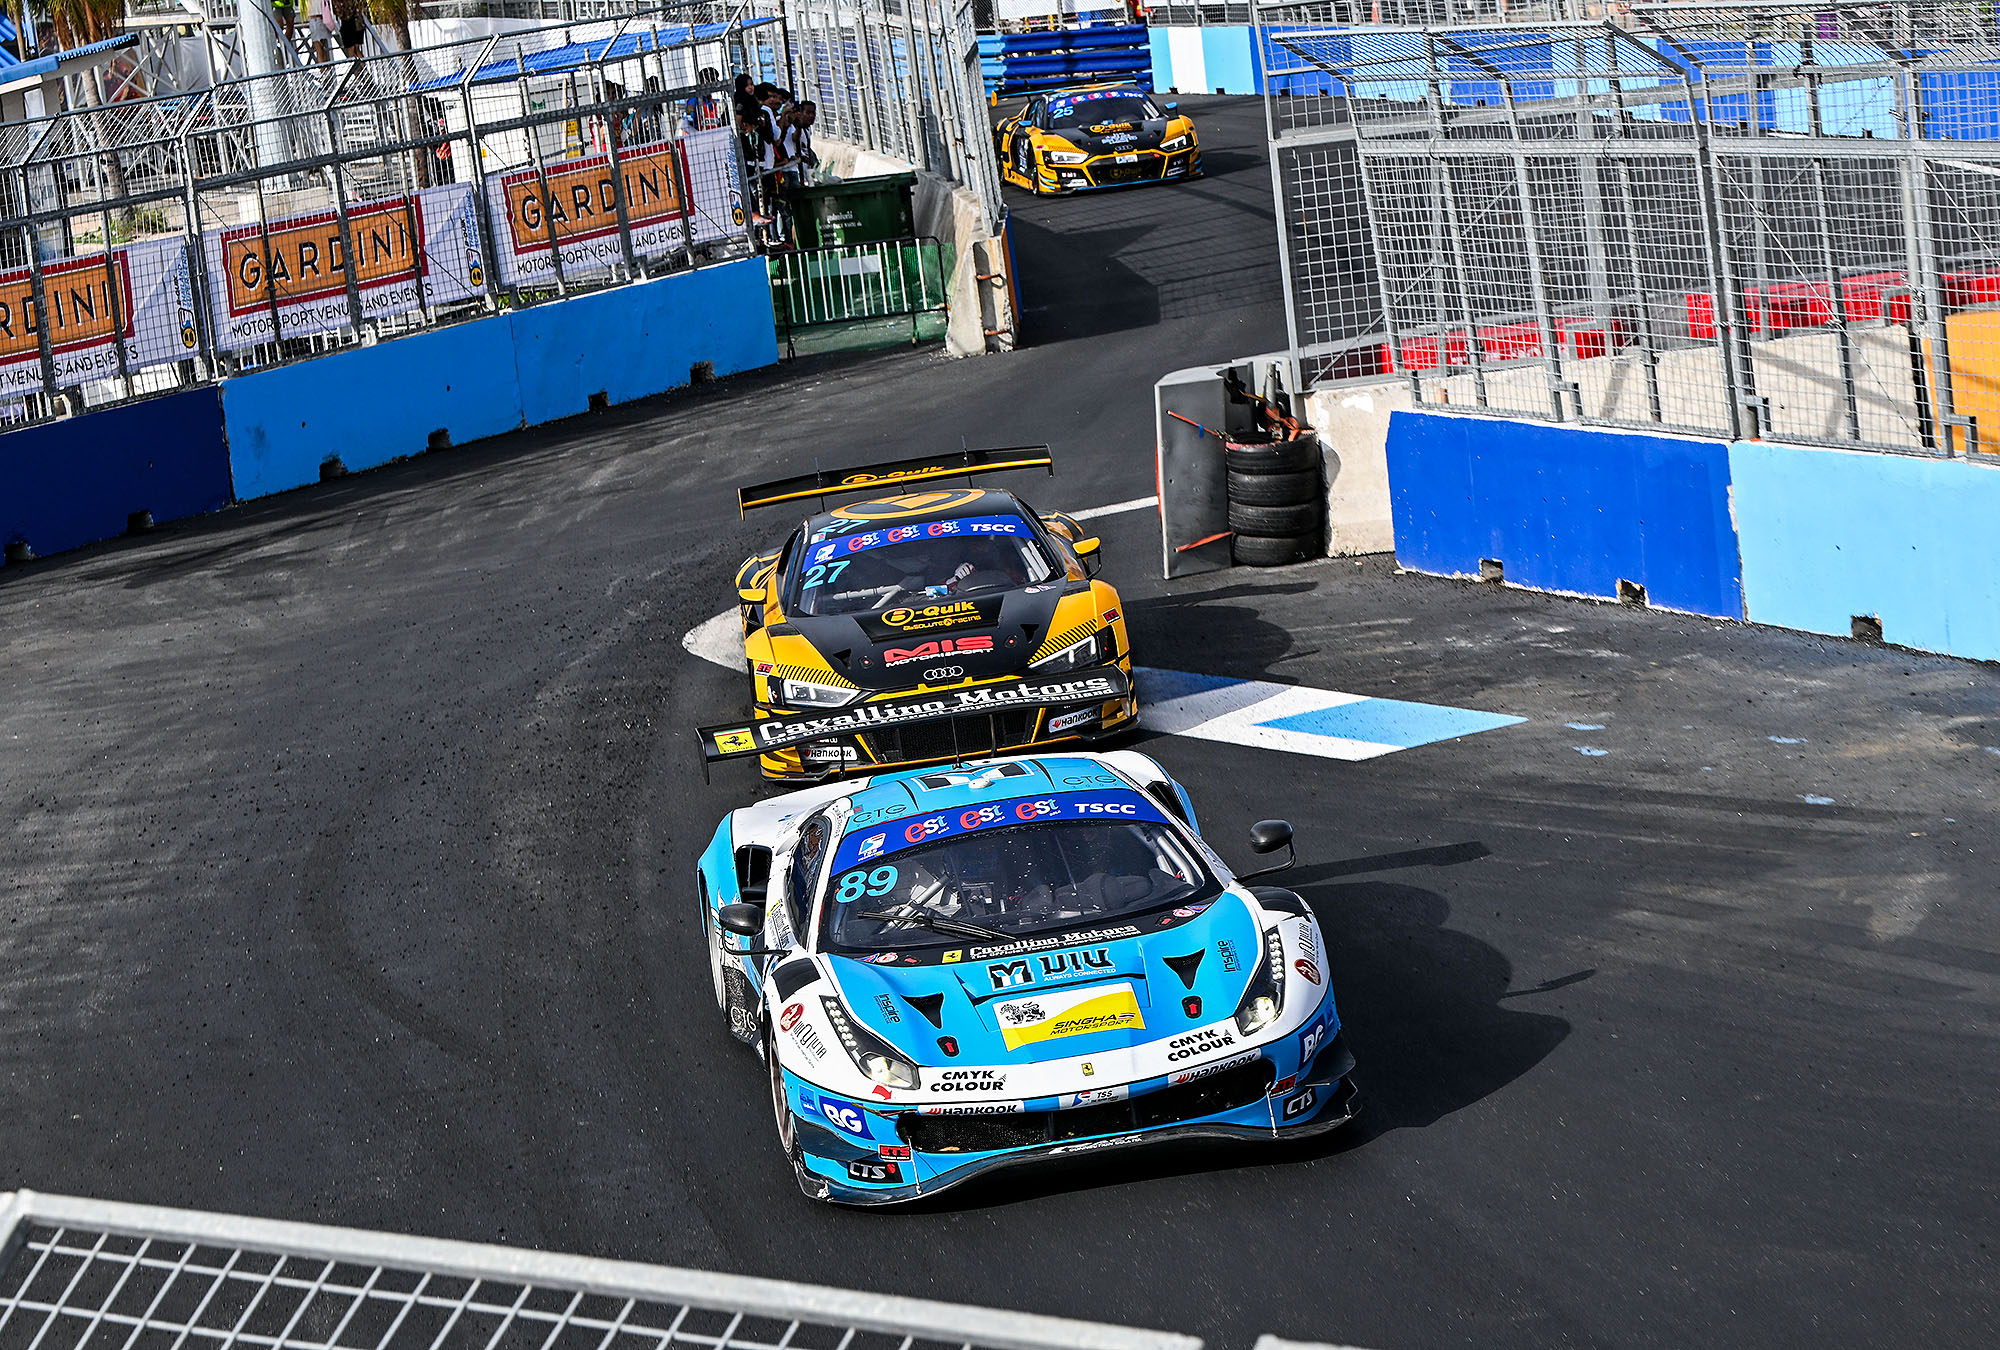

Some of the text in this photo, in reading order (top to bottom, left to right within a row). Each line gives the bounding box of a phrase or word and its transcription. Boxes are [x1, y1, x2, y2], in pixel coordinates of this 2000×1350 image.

[1053, 106, 1074, 119] 25
[521, 163, 673, 231] GARDINI
[589, 241, 622, 259] VENU
[635, 232, 657, 249] AND
[659, 223, 698, 243] EVENS
[239, 223, 407, 290] GARDINI
[365, 294, 389, 311] AND
[390, 283, 434, 305] EVENS
[6, 362, 63, 385] VENUS
[65, 356, 94, 376] AND
[848, 532, 879, 551] est
[888, 524, 919, 542] est
[928, 521, 959, 536] est
[970, 524, 1016, 533] TSCC
[803, 560, 850, 590] 27
[882, 602, 976, 626] B-Quik
[884, 636, 994, 662] MIS
[886, 648, 994, 668] MOTORSPORT
[759, 677, 1110, 741] Cavallino Motors
[904, 799, 1136, 843] est est est TSCC
[835, 865, 899, 903] 89
[970, 925, 1140, 956] Cavallino Motors
[1044, 968, 1116, 982] ALWAYS CONNECTED
[1050, 1019, 1133, 1036] MOTORSPORT
[1053, 1014, 1117, 1030] SINGHA
[1168, 1036, 1236, 1061] COLOUR
[1169, 1029, 1219, 1048] CMYK
[930, 1081, 1004, 1092] COLOUR
[942, 1070, 994, 1080] CMYK
[1287, 1088, 1313, 1114] CTS
[823, 1103, 862, 1133] BG
[881, 1146, 910, 1156] ETS
[850, 1162, 886, 1179] CTS
